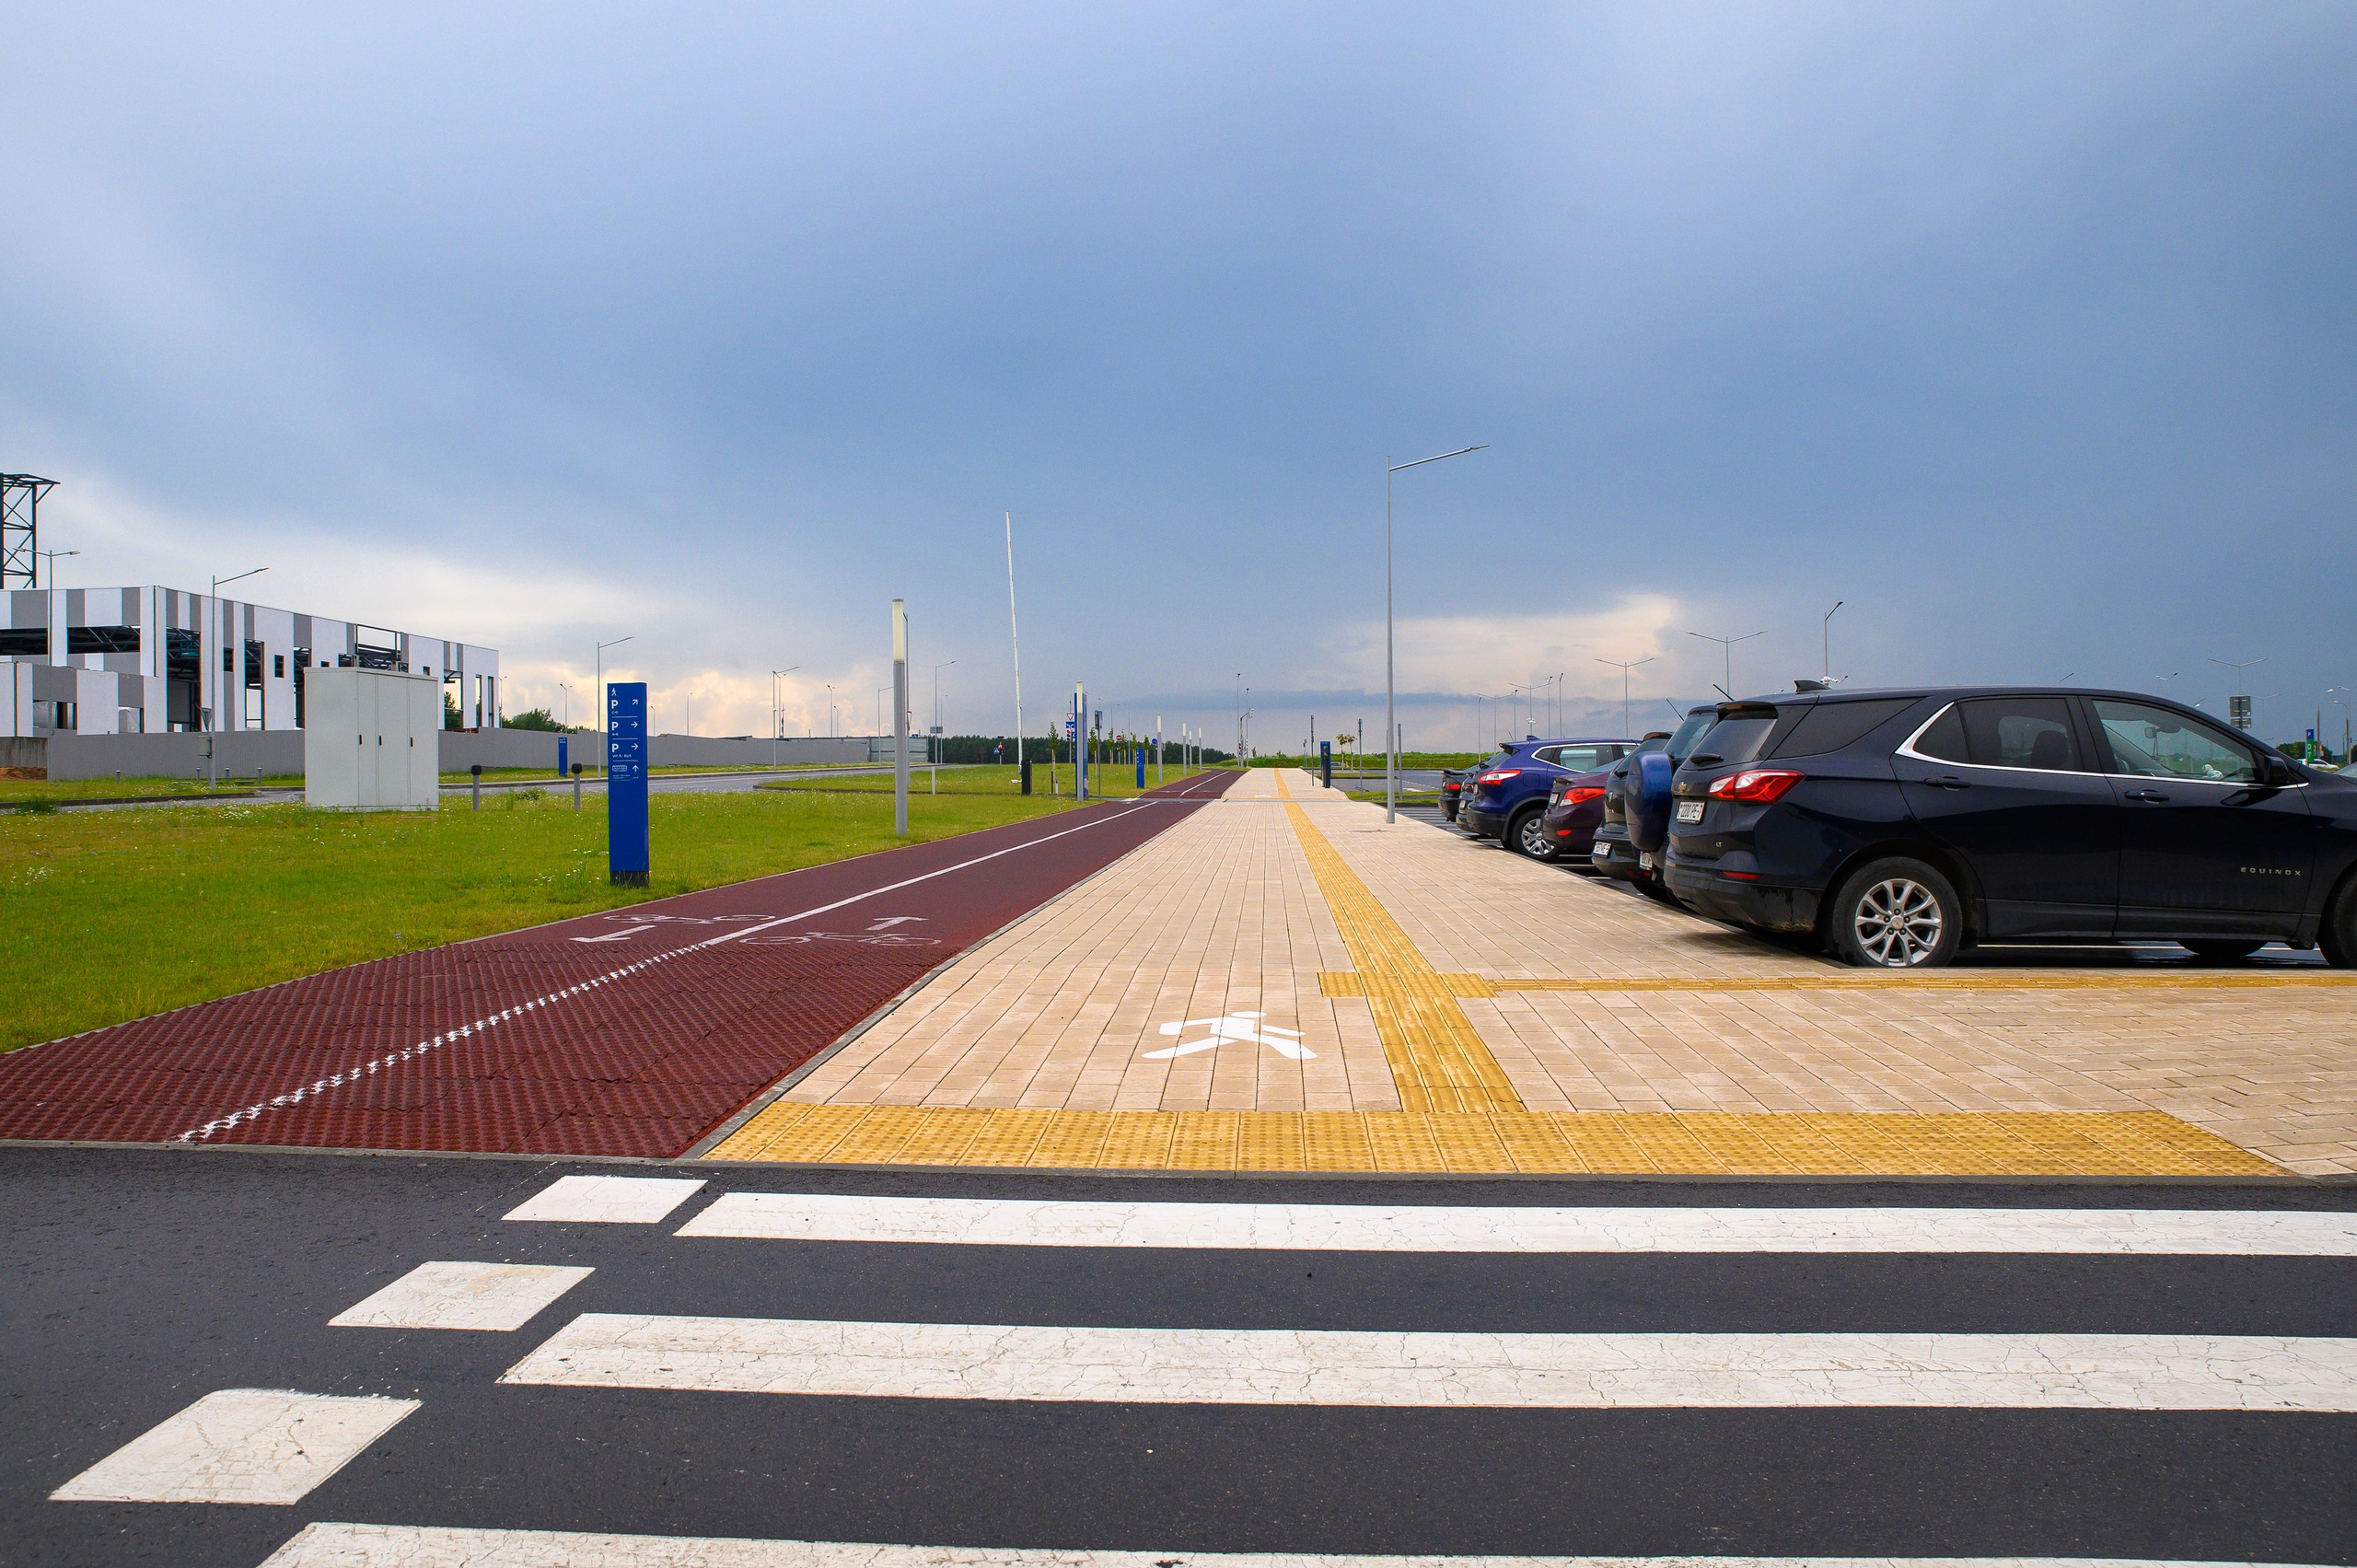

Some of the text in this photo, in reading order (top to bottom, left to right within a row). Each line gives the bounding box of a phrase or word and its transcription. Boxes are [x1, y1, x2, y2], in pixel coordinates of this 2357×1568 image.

[611, 700, 619, 709] P
[612, 721, 619, 731] P
[612, 743, 619, 753] P
